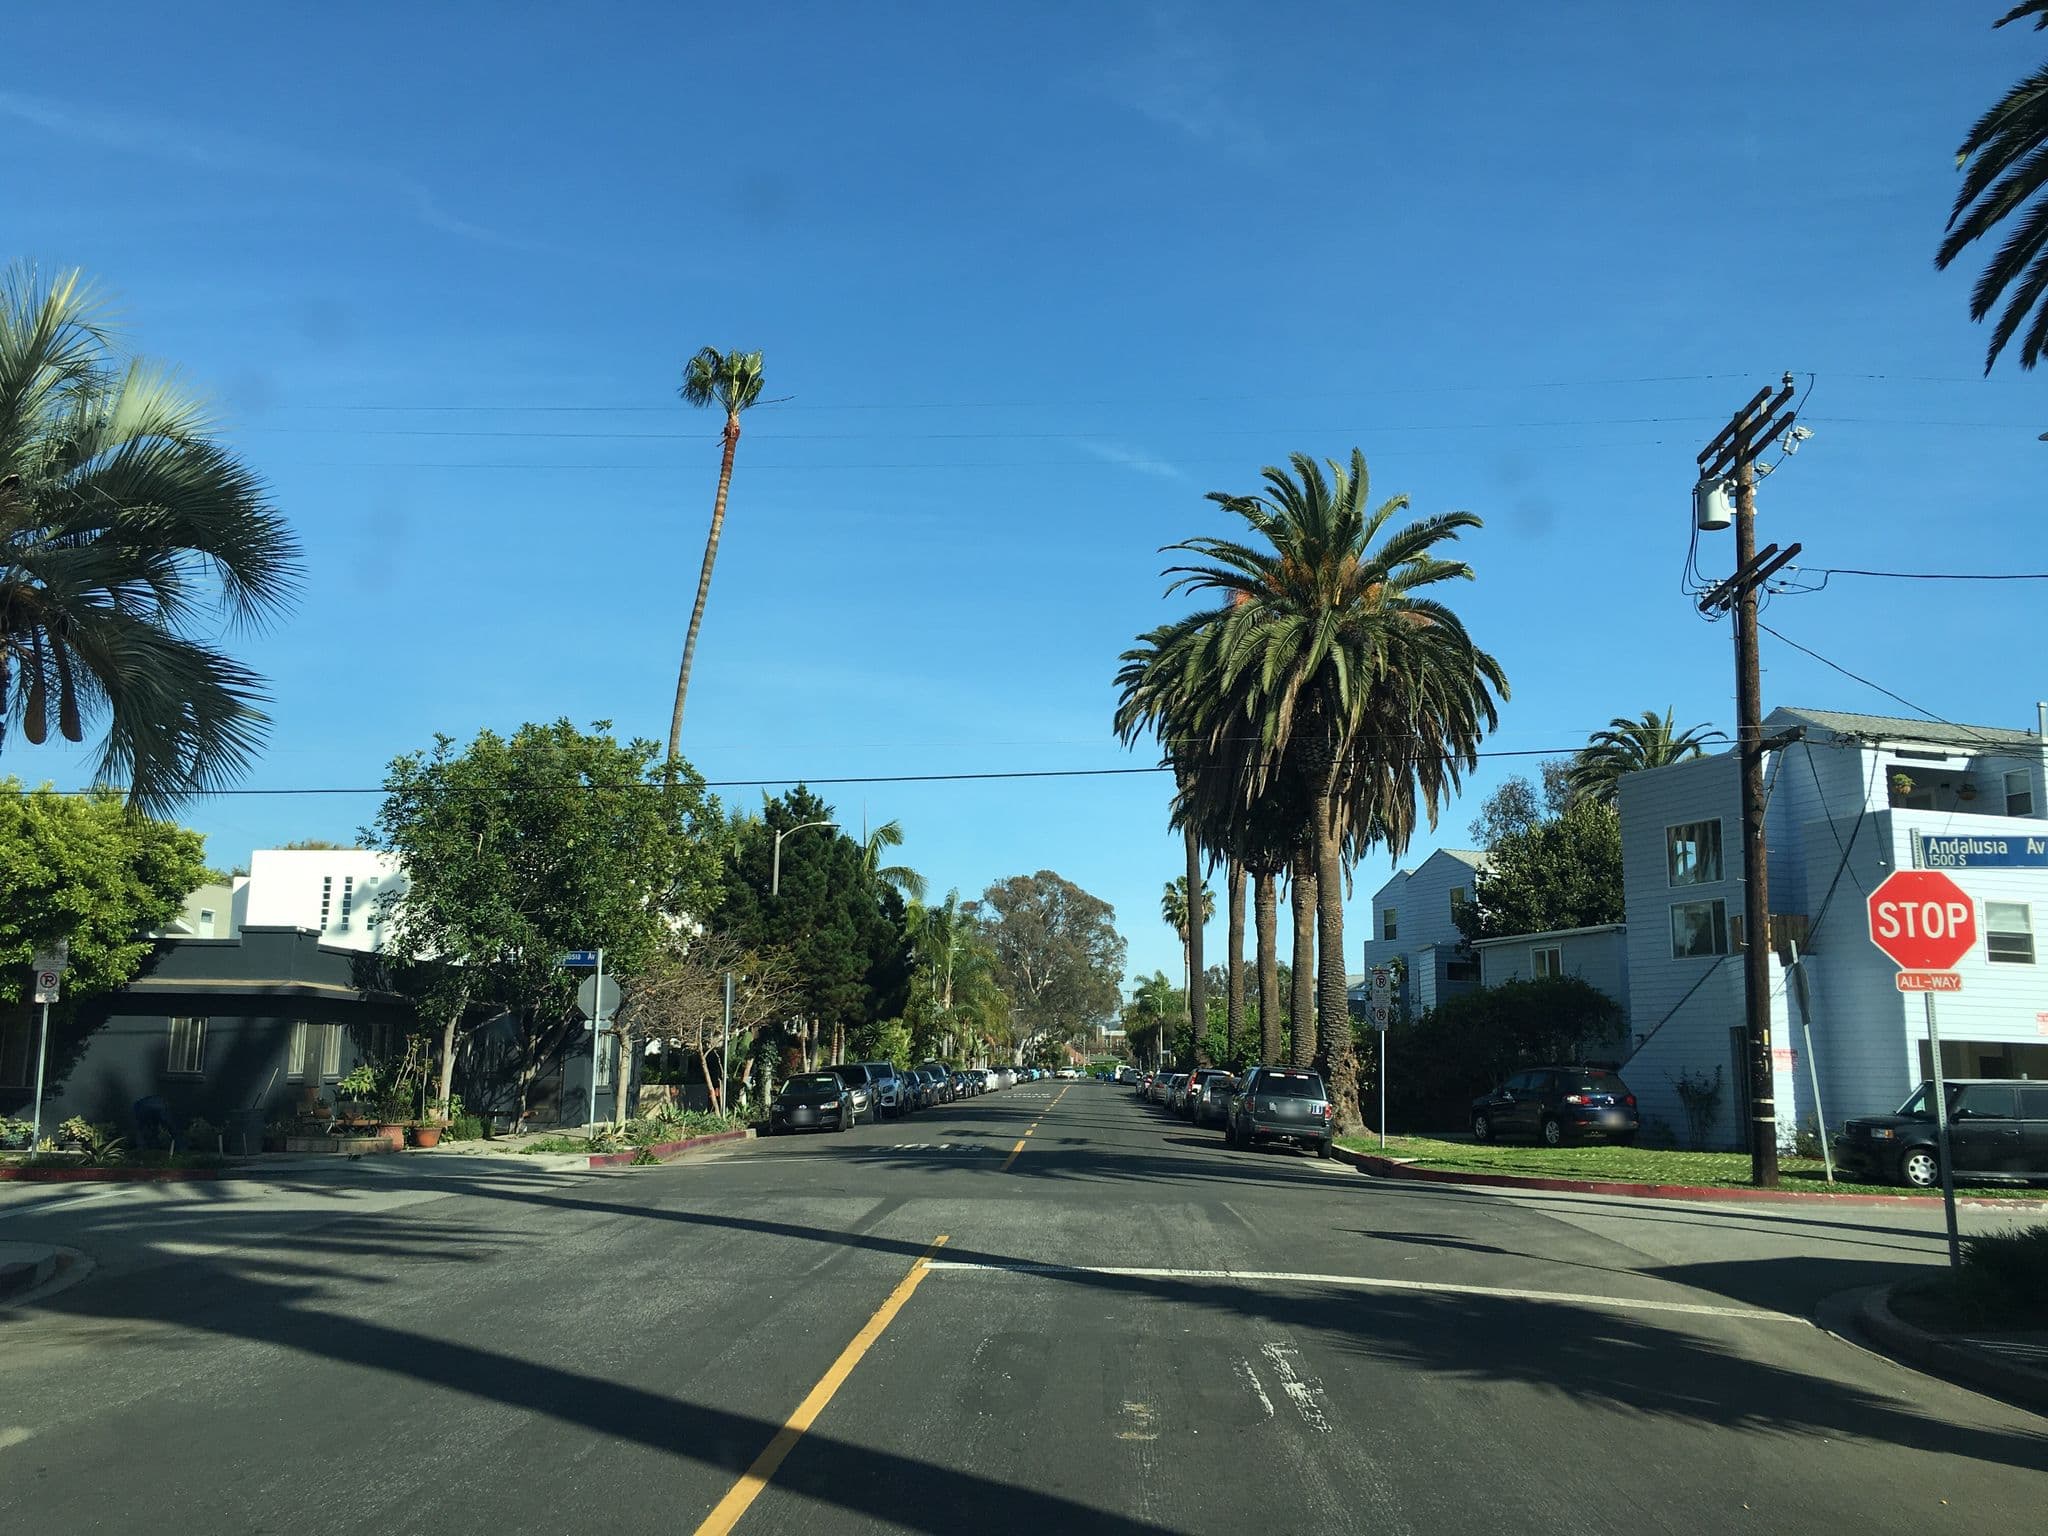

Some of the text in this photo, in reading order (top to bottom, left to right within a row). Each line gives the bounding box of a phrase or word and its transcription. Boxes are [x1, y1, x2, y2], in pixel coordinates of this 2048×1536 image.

[1928, 838, 2046, 855] Andalusia Av
[1929, 855, 1967, 866] 1500 S
[1877, 901, 1968, 939] STOP
[1900, 976, 1960, 989] ALL-WAY
